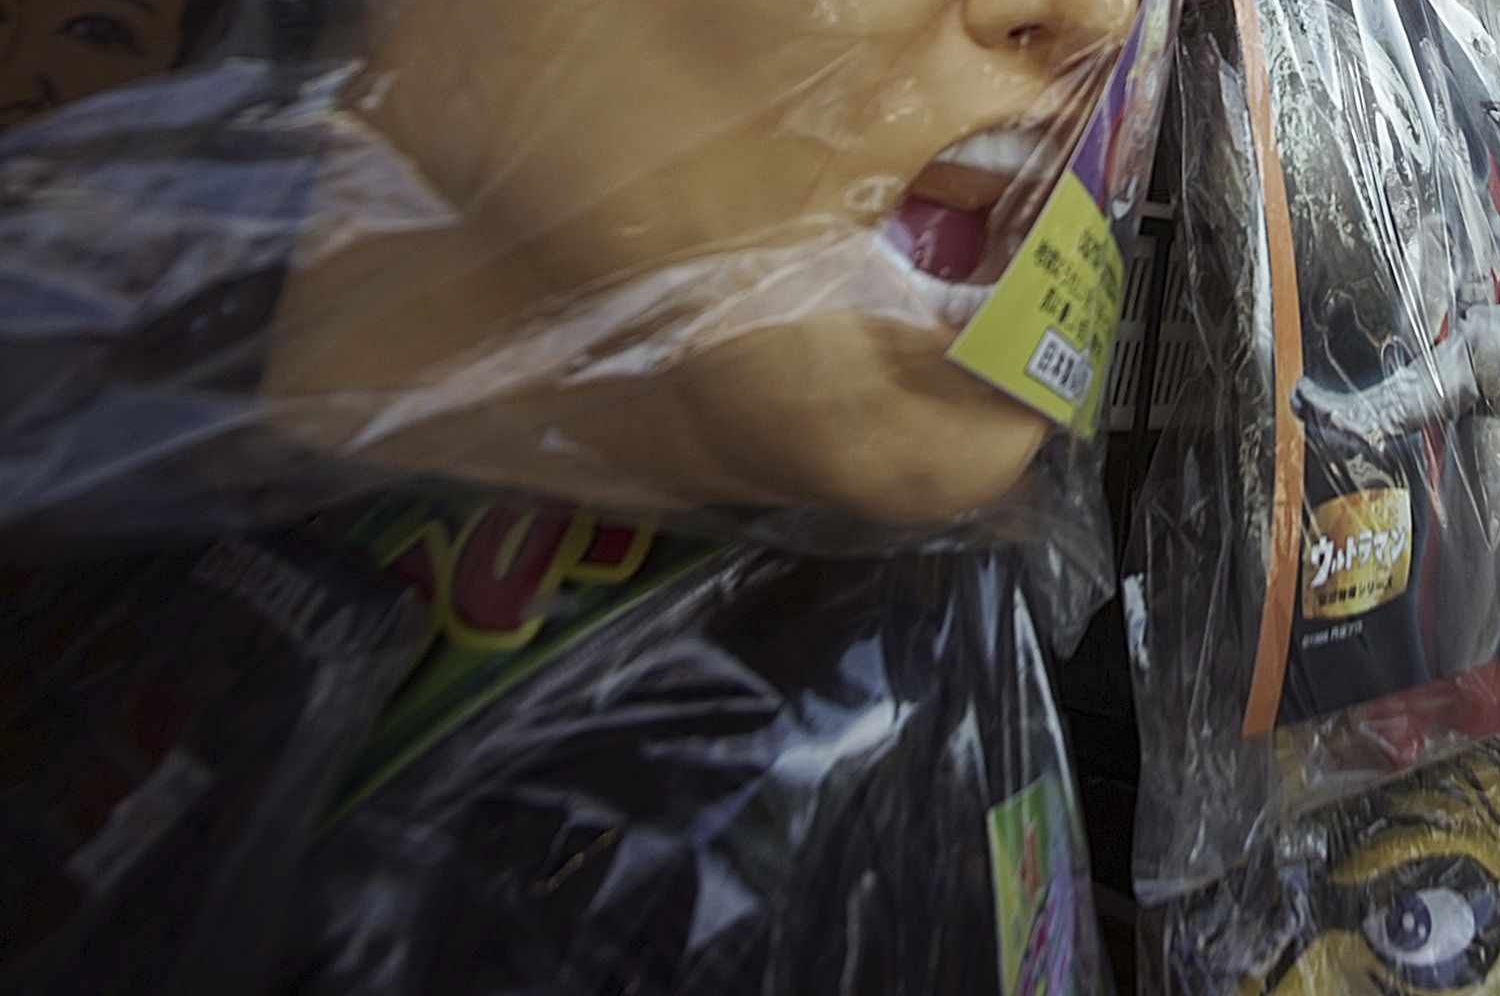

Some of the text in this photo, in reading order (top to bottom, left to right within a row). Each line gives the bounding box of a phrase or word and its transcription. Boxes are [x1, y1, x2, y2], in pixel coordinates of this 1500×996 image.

[1309, 526, 1408, 590] ウルトラマン
